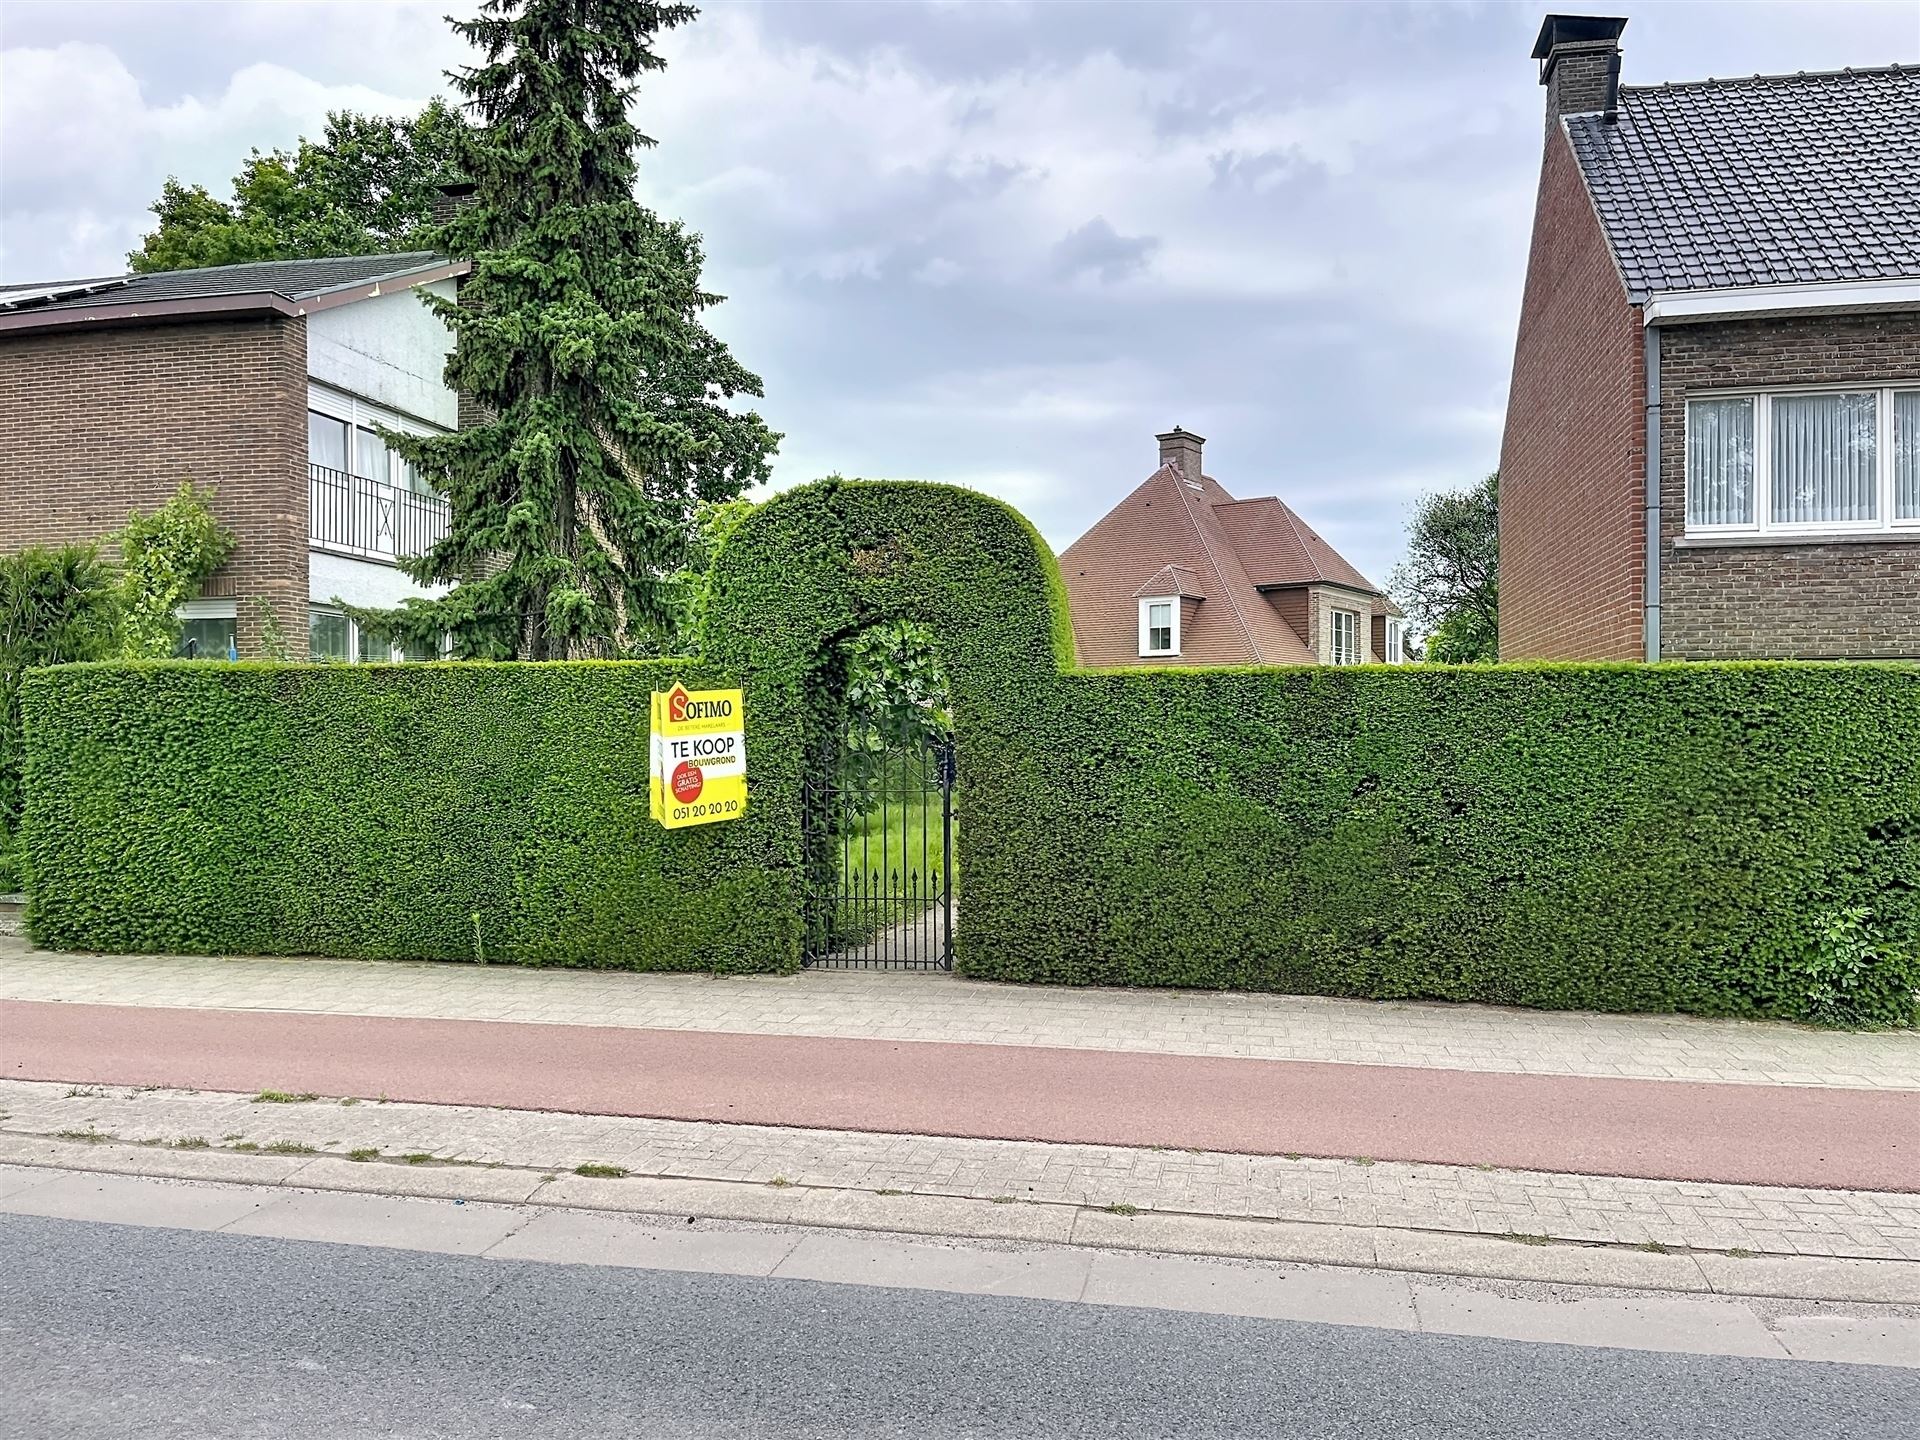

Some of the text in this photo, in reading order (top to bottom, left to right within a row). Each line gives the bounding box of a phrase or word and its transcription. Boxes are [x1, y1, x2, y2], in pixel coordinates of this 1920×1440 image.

[673, 695, 732, 721] SOFIMO
[671, 741, 689, 758] TE
[693, 737, 735, 756] KOOP
[688, 755, 736, 768] BOUWGROND
[677, 776, 699, 787] GRATIS
[673, 807, 690, 820] 051
[692, 804, 706, 817] 20
[709, 802, 722, 814] 20
[725, 800, 738, 812] 20
